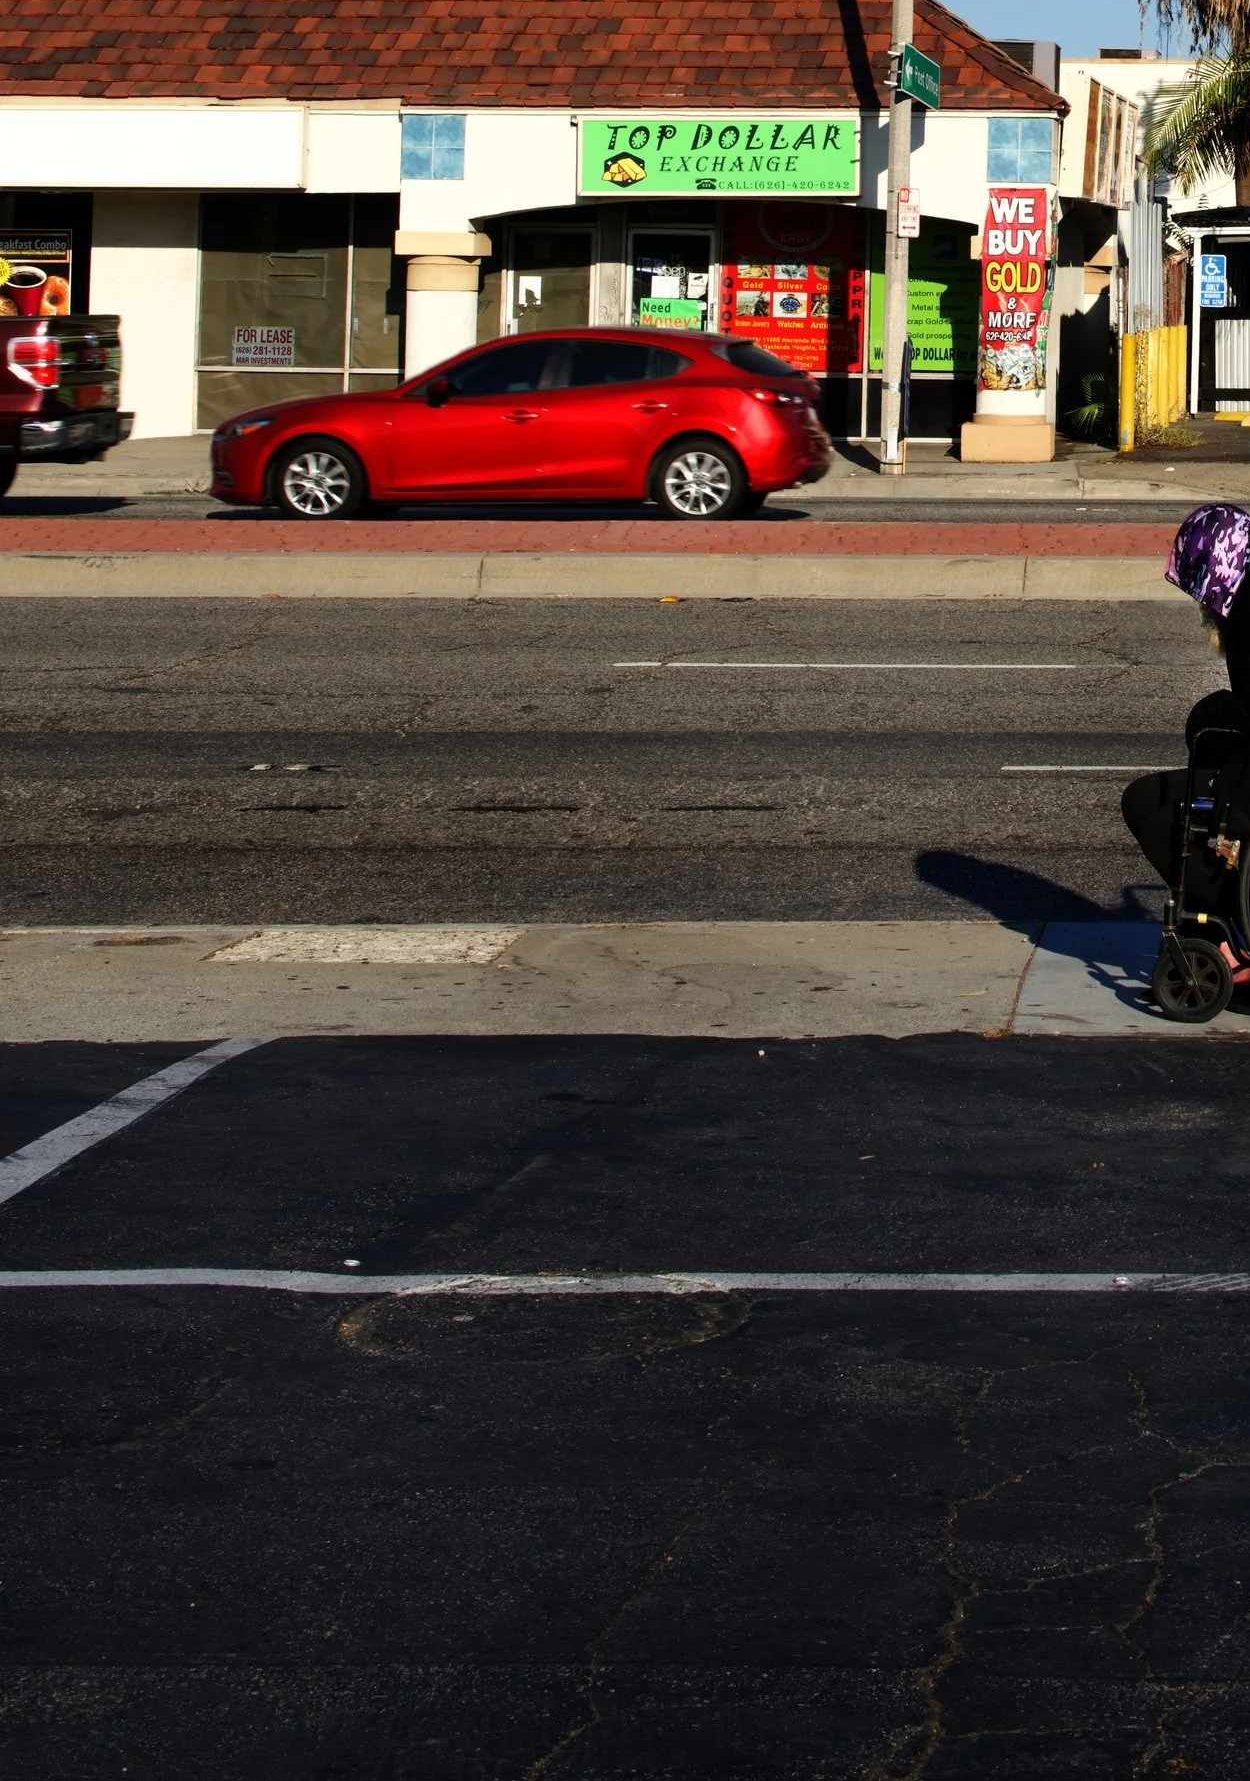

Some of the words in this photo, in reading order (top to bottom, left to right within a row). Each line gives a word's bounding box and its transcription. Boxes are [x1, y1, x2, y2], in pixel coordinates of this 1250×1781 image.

[914, 65, 925, 88] Post
[925, 73, 939, 96] Office
[607, 124, 677, 151] TOP
[690, 124, 843, 151] DOLLAR
[659, 156, 799, 172] EXCHANGE
[991, 197, 1036, 224] WE
[34, 239, 67, 250] Combo
[988, 229, 1043, 256] BUY
[986, 261, 1042, 293] GOLD
[1201, 275, 1225, 283] PARKING
[742, 281, 764, 289] Gold
[777, 281, 804, 290] Silver
[816, 282, 841, 291] Coins
[642, 302, 671, 313] Need
[1007, 297, 1018, 310] &
[641, 314, 699, 329] Money?
[752, 321, 770, 329] Jewelry
[777, 321, 804, 329] Watches
[988, 312, 1037, 329] MORE
[236, 329, 257, 343] FOR
[260, 330, 292, 343] LEASE
[235, 346, 252, 354] (626)
[252, 346, 292, 356] 281-1128
[923, 348, 955, 360] DOLLAR
[251, 357, 292, 365] INVESTMENTS
